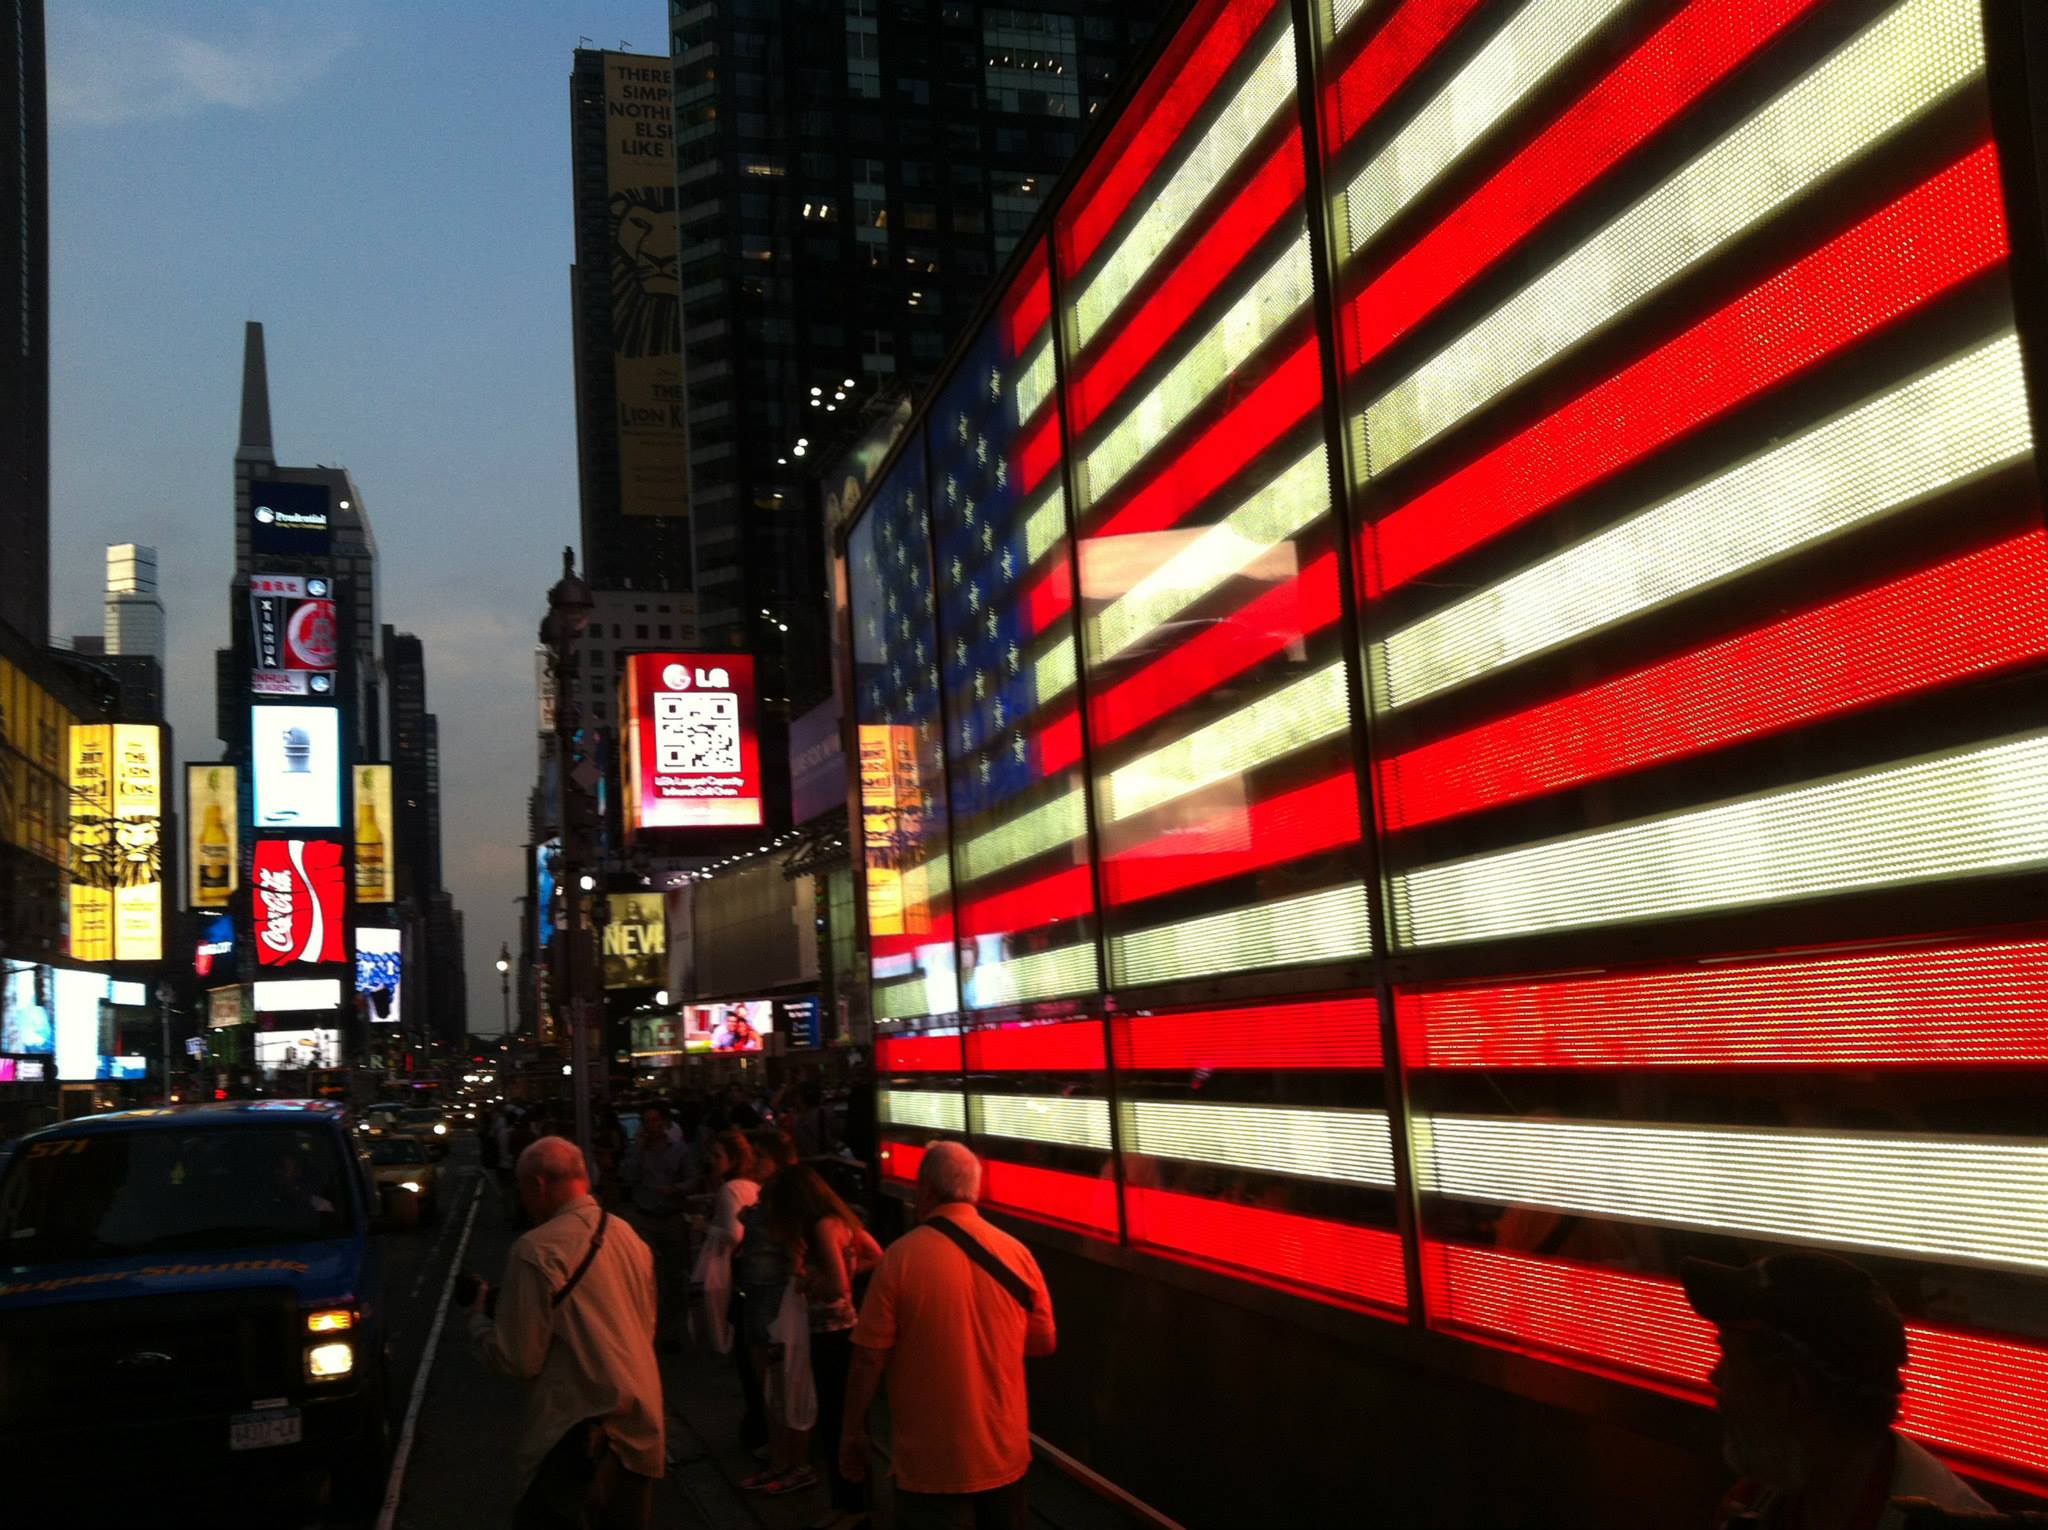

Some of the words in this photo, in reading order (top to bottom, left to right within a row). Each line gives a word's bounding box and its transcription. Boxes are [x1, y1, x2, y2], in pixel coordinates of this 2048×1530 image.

[622, 139, 664, 157] LIKE
[260, 868, 294, 952] Coca-Cola
[23, 1137, 94, 1159] 571
